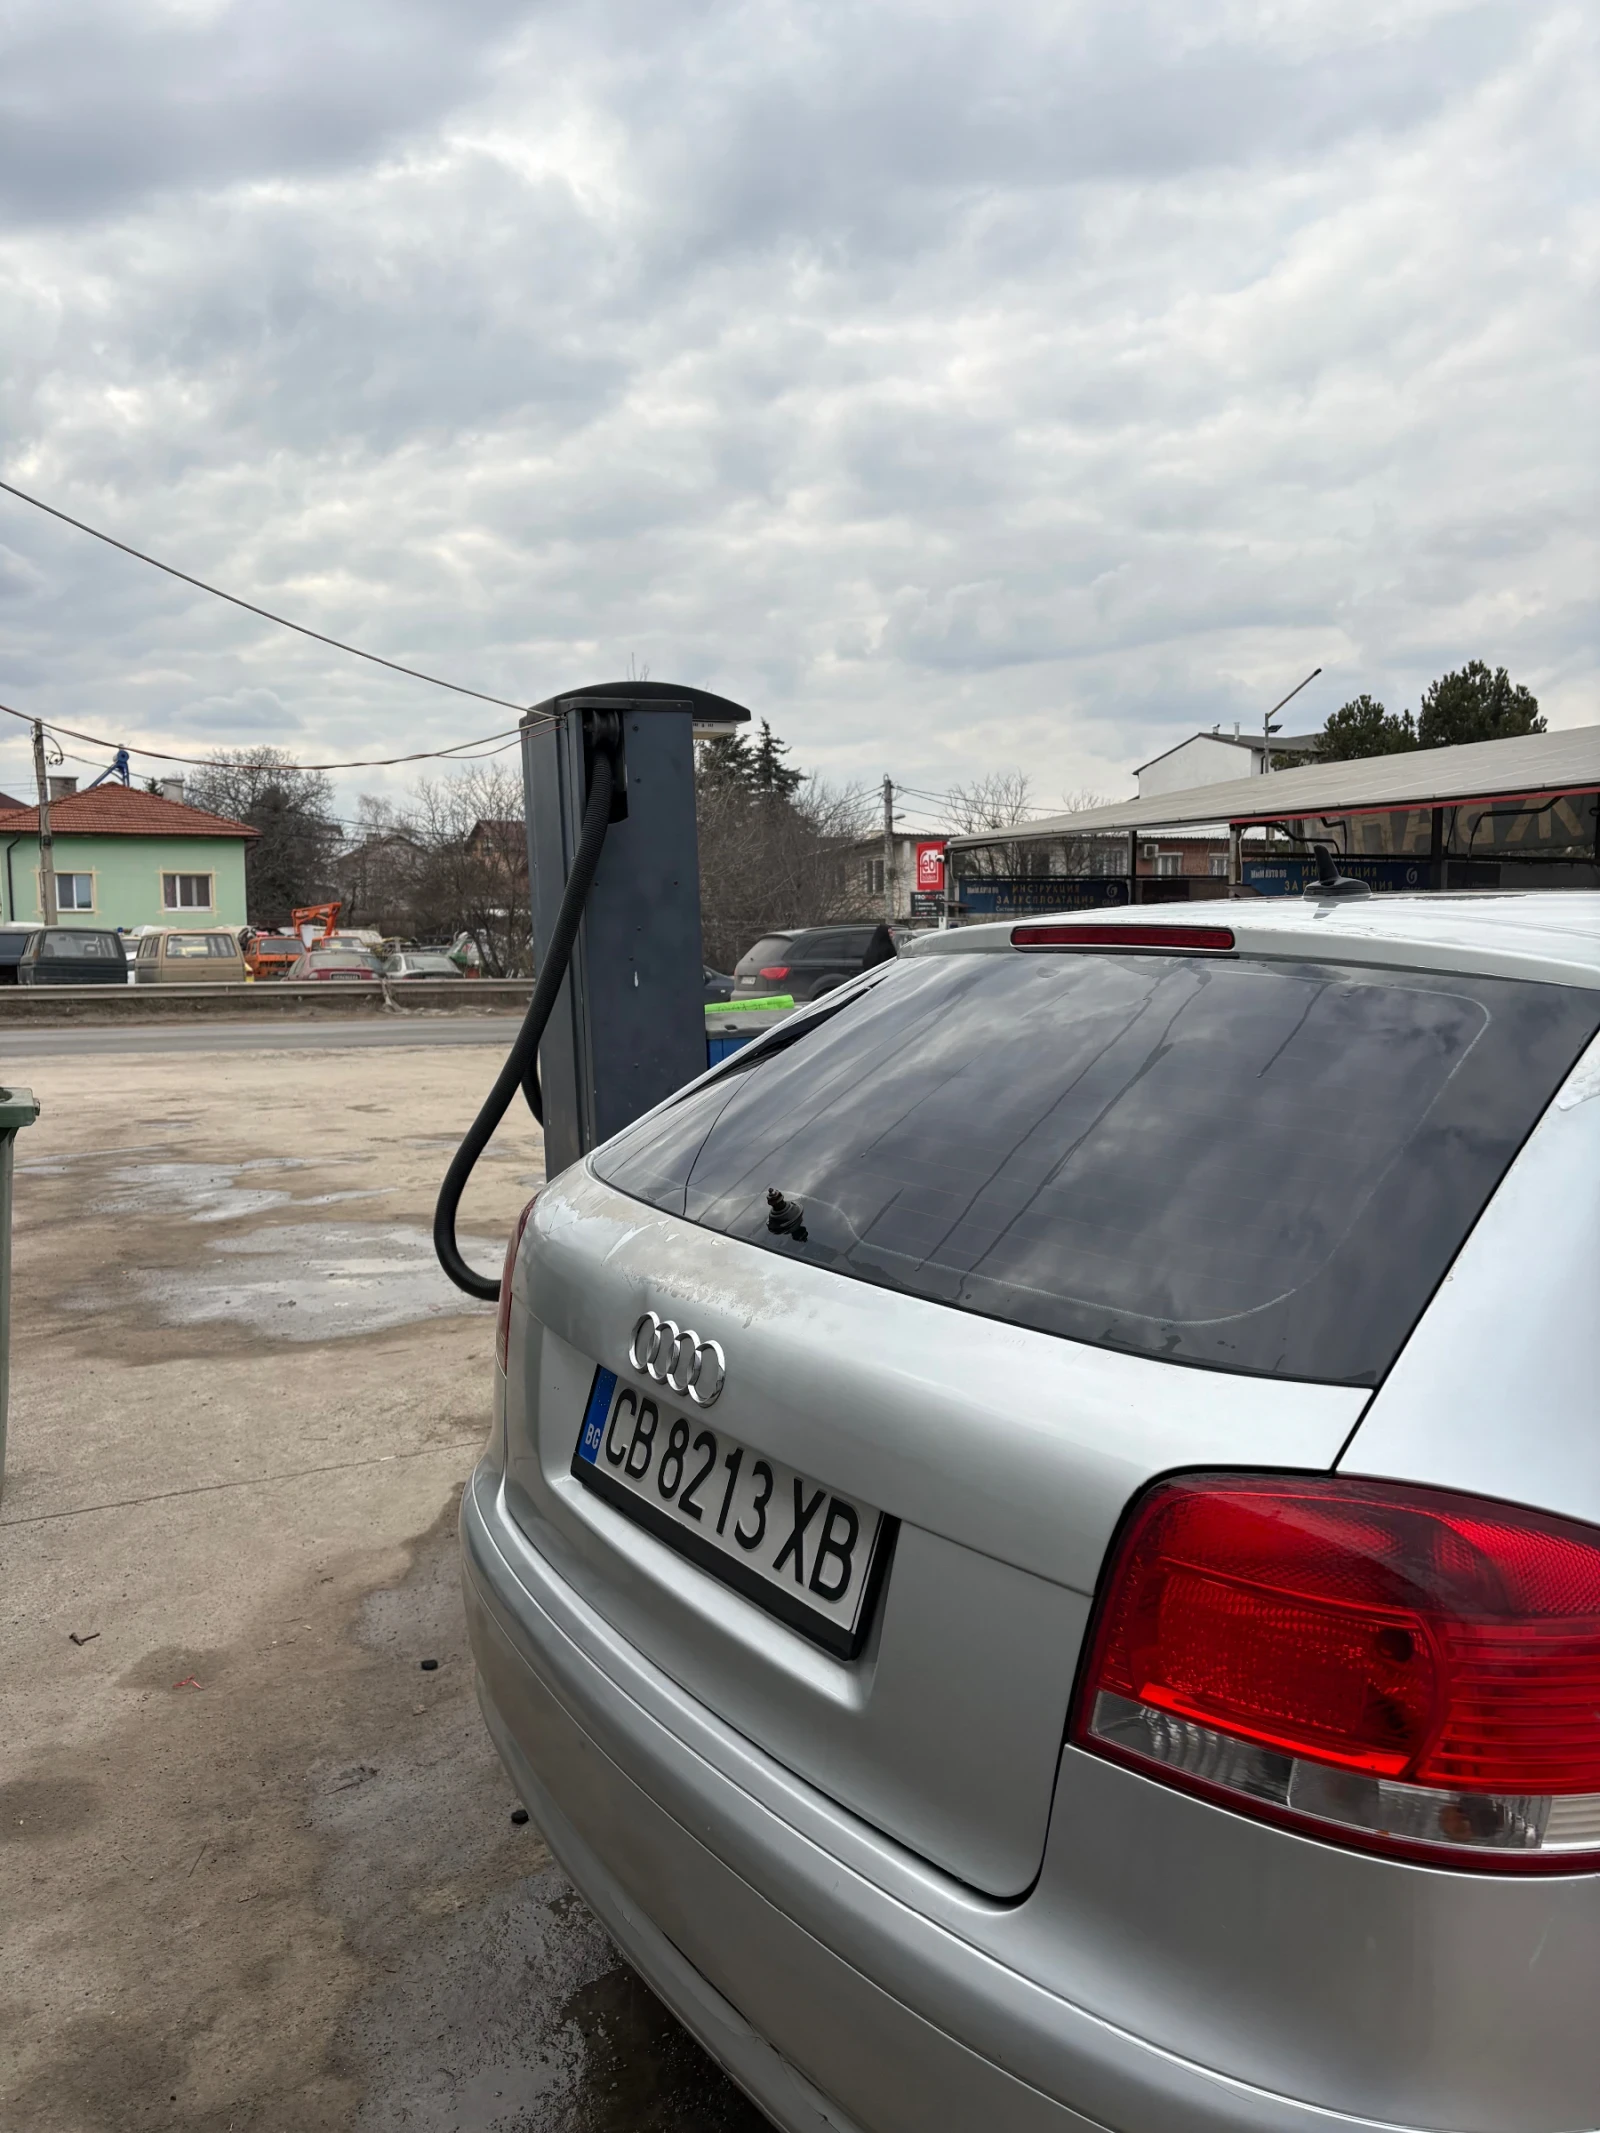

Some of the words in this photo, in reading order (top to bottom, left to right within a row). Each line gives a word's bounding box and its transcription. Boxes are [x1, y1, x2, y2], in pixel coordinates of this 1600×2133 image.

[1302, 866, 1377, 878] ИНУКЦИЯ
[1012, 884, 1080, 893] ИНСТРУКЦИЯ
[1285, 880, 1298, 891] ЗА
[996, 896, 1009, 904] ЗА
[1013, 896, 1094, 905] ЕКСПЛОАТАЦИЯ
[585, 1423, 601, 1450] BG
[605, 1389, 659, 1480] CB
[657, 1419, 774, 1550] 8213
[773, 1478, 859, 1602] XB
